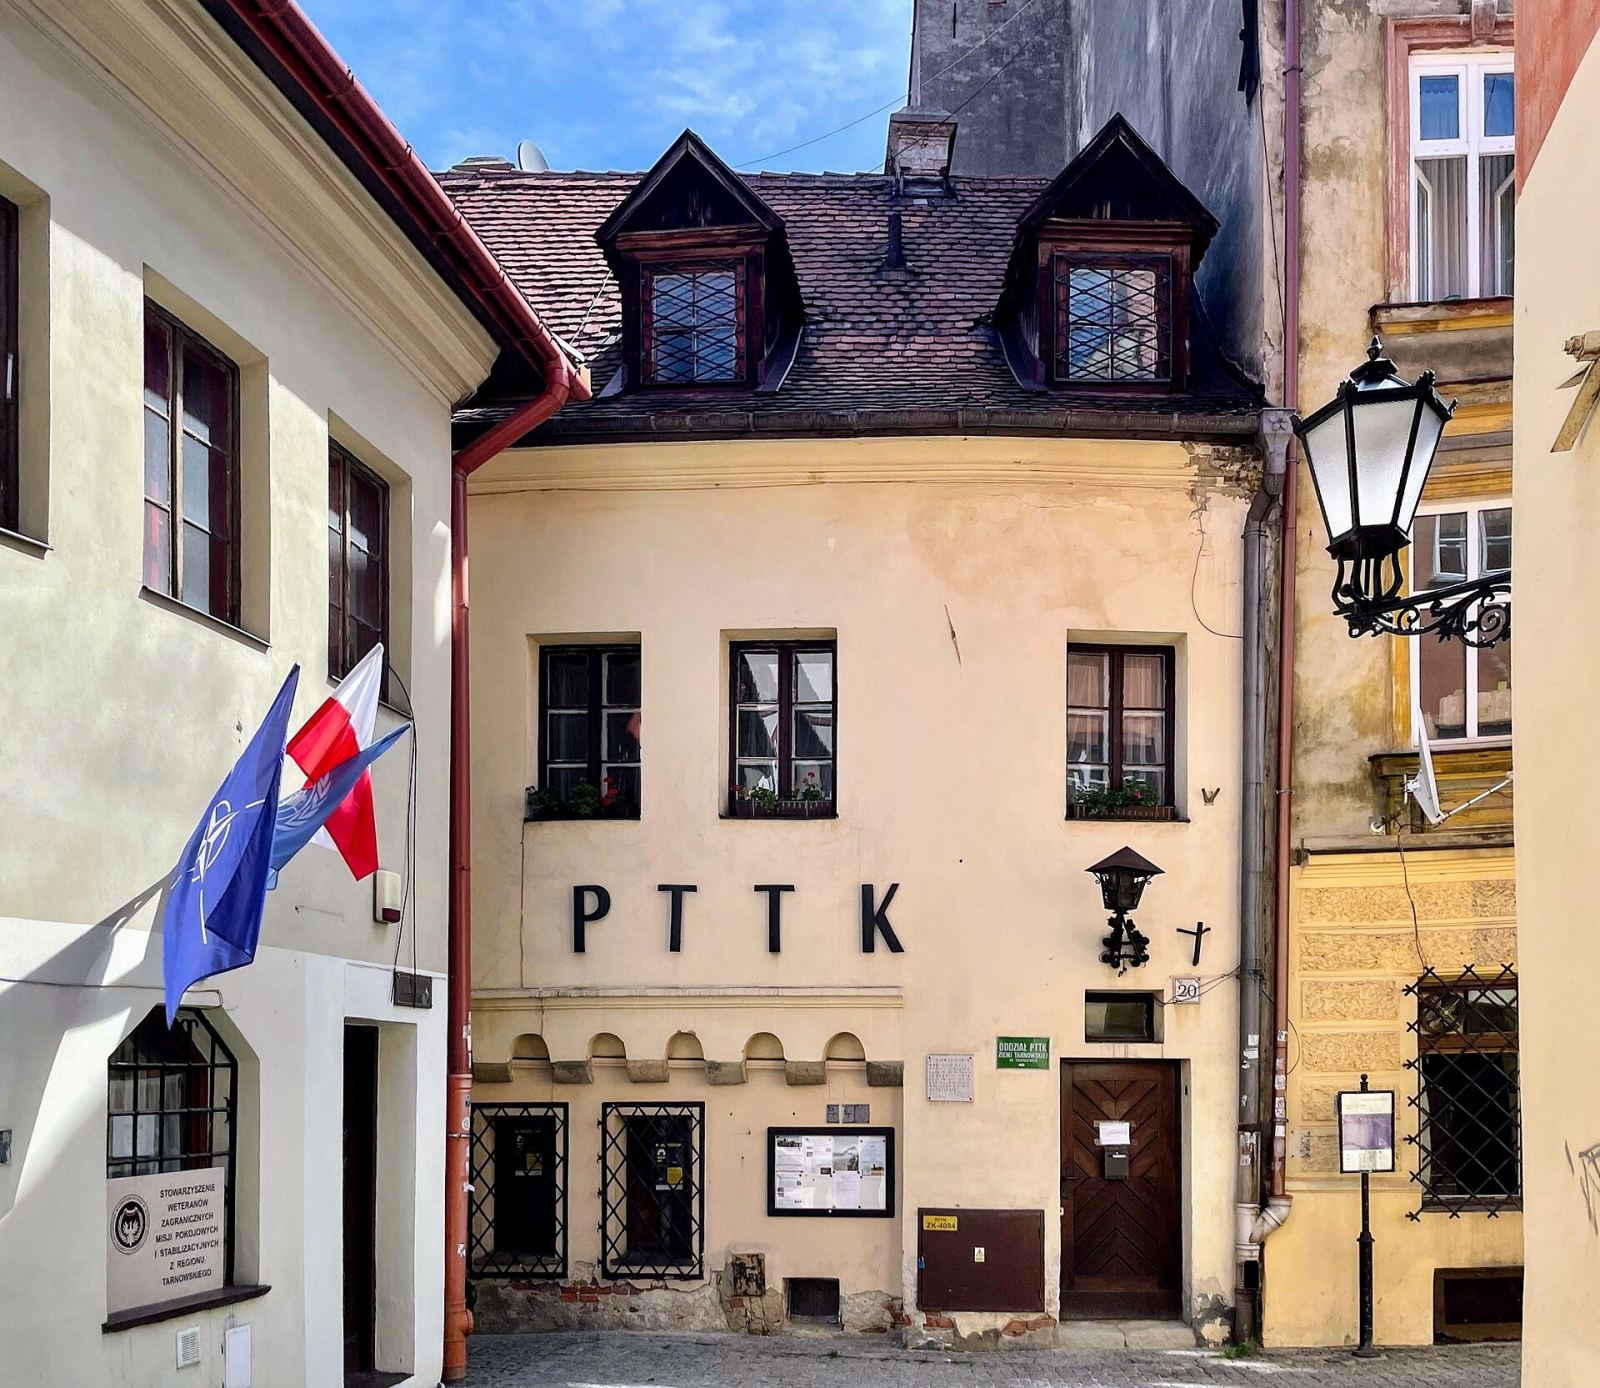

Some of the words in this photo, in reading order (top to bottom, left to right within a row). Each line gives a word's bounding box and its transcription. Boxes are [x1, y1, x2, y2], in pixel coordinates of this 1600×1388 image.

[1178, 984, 1197, 998] 20
[999, 1042, 1027, 1052] ODDZIAŁ
[1030, 1042, 1047, 1052] PTTK
[160, 1183, 215, 1199] STOWARZYSZENIE
[167, 1198, 209, 1213] WETERANÓW
[161, 1212, 214, 1228] ZAGRANICZNYCH
[926, 1222, 956, 1230] ZK-4084
[155, 1233, 172, 1243] MISJI
[175, 1225, 219, 1240] POKOJOWYCH
[160, 1239, 219, 1257] STABILIZACYJNYCH
[169, 1261, 175, 1270] Z
[177, 1256, 205, 1269] REGIONU
[161, 1268, 212, 1286] TARNOWSKIEGO
